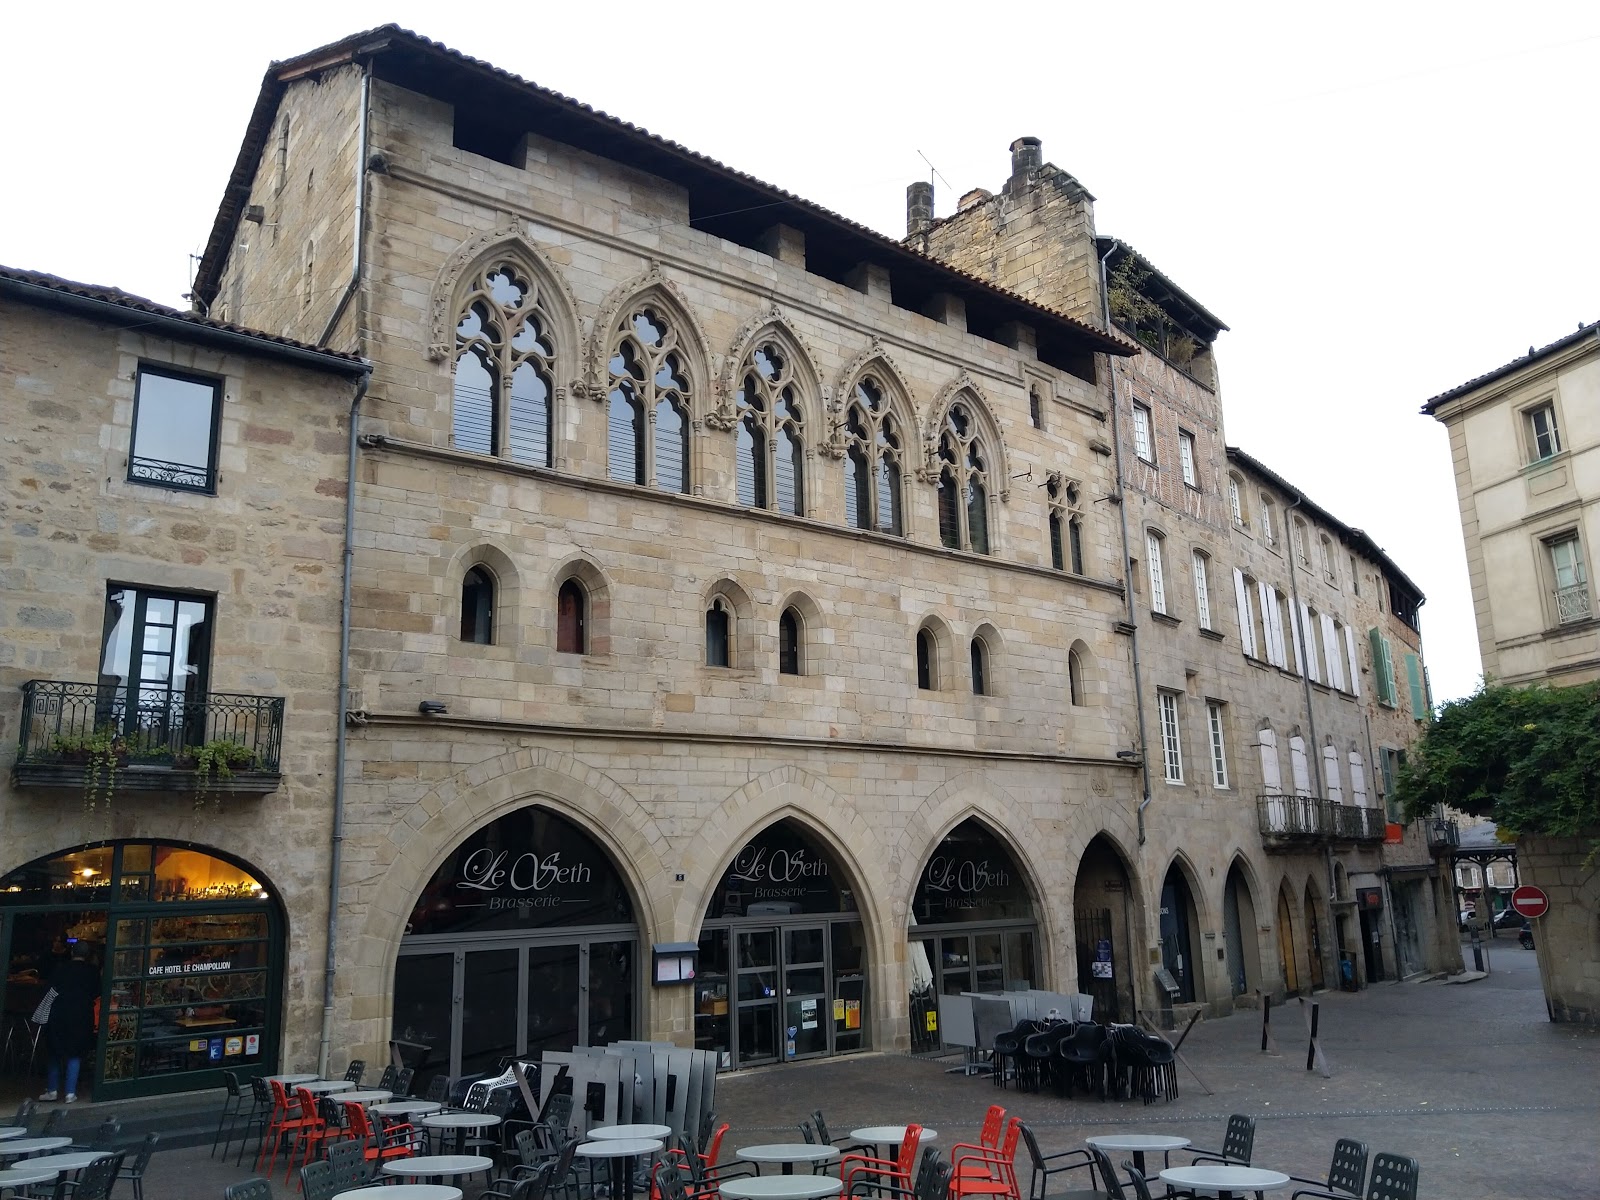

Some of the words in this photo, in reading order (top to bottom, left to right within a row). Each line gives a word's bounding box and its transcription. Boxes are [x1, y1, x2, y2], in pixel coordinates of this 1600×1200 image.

[455, 847, 509, 891] Le
[730, 844, 767, 882] Le
[925, 855, 957, 892] Le
[753, 885, 807, 898] Brasserie
[488, 894, 561, 910] Brasserie
[944, 895, 994, 909] Brasserie
[148, 966, 164, 975] CAFE
[164, 964, 182, 974] HOTEL
[183, 964, 191, 972] LE
[191, 961, 231, 972] CHAMPOLLION
